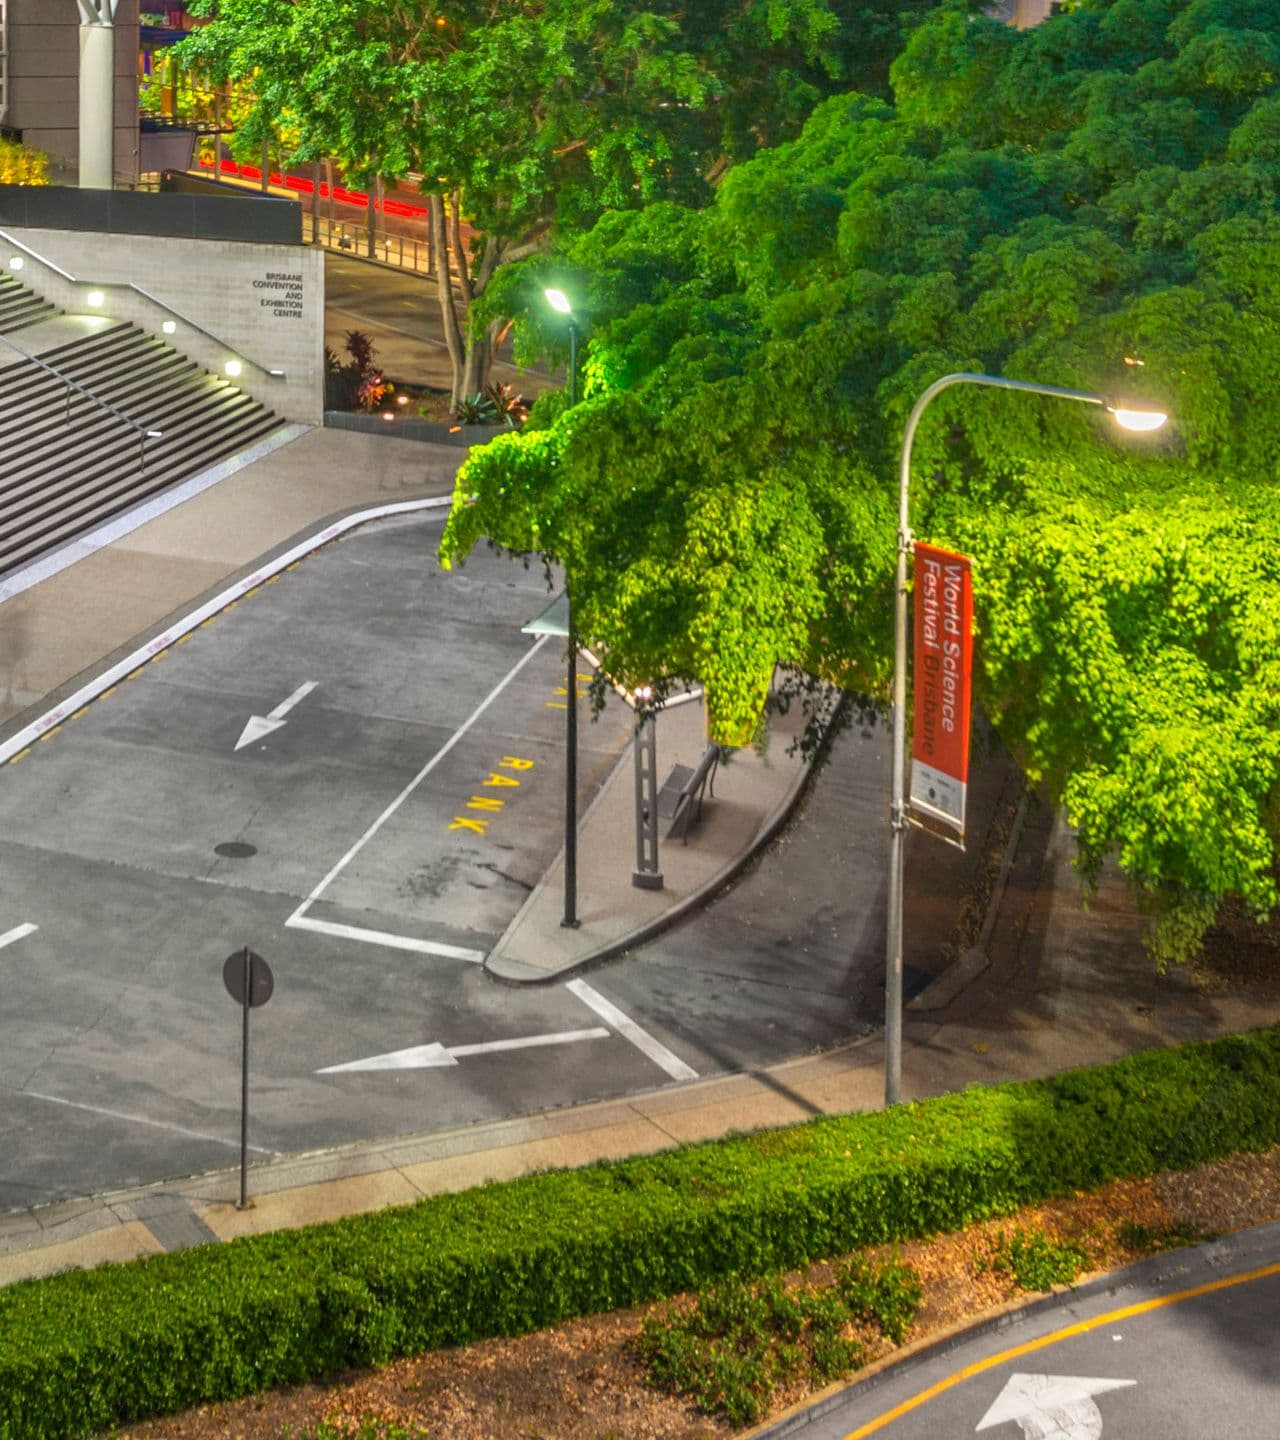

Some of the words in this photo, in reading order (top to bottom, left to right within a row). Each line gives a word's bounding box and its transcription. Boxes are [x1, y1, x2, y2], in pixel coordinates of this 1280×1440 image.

[252, 280, 303, 291] CONVENTION
[266, 272, 303, 282] BRISBANE
[285, 292, 303, 300] AND
[260, 298, 303, 309] EXHIBITION
[273, 309, 302, 318] CENTRE
[923, 559, 941, 649] Festival
[944, 565, 962, 636] World
[923, 654, 940, 757] Brisbane
[942, 640, 961, 733] Science
[448, 755, 535, 835] RANK
